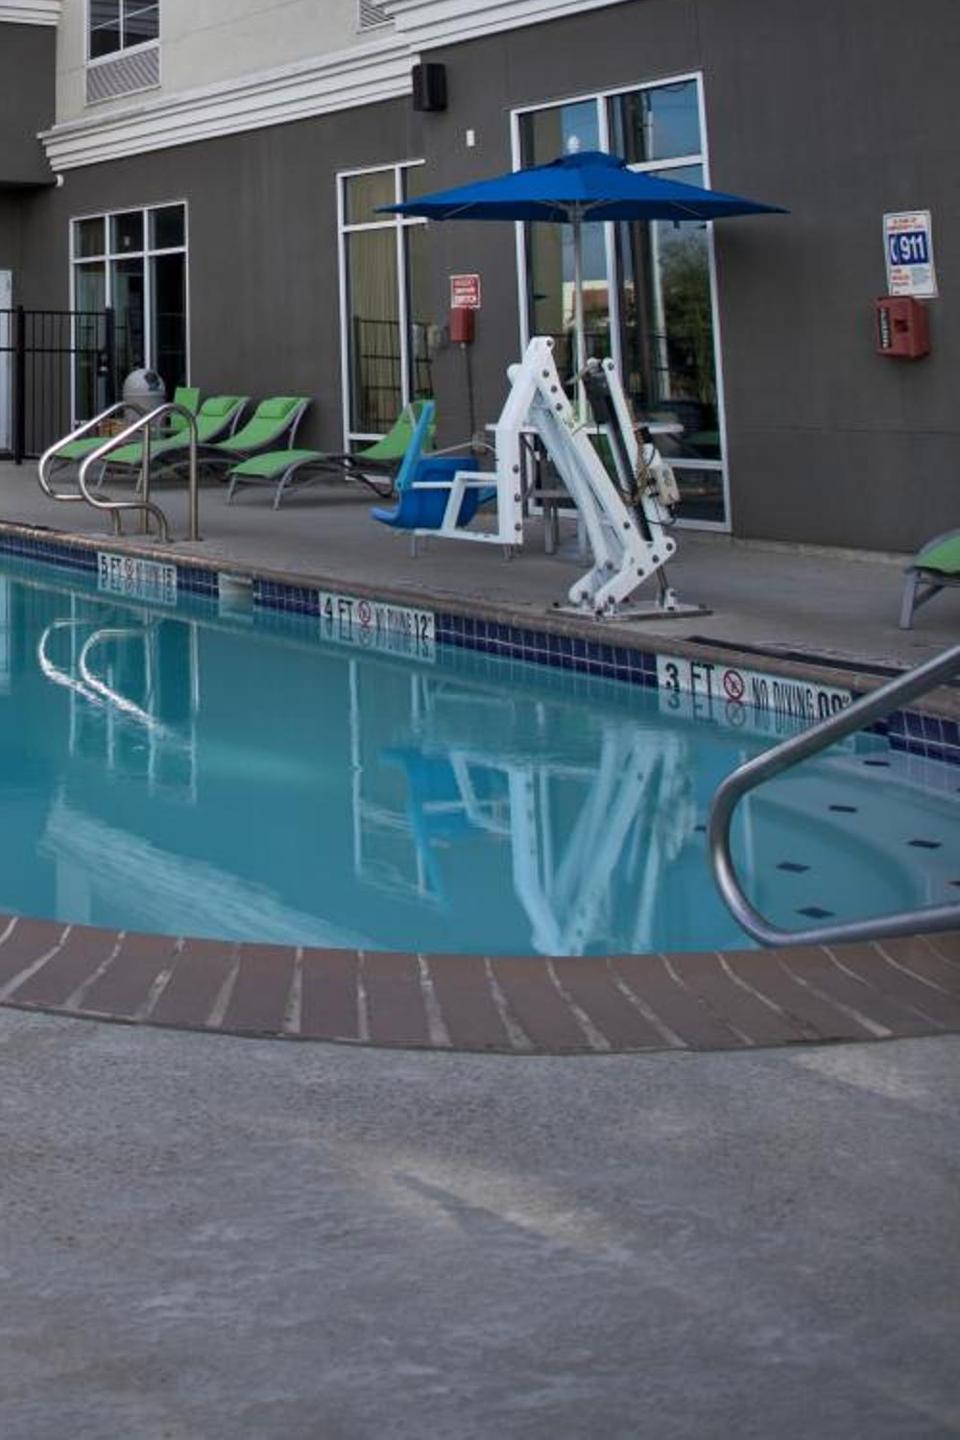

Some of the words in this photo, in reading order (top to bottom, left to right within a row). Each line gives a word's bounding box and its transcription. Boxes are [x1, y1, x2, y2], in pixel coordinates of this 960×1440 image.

[899, 234, 926, 261] 911
[325, 597, 333, 620] 4
[338, 599, 353, 625] FT
[665, 662, 680, 693] 3
[690, 661, 715, 699] FT
[752, 677, 769, 711] NO
[773, 681, 815, 722] DIVING
